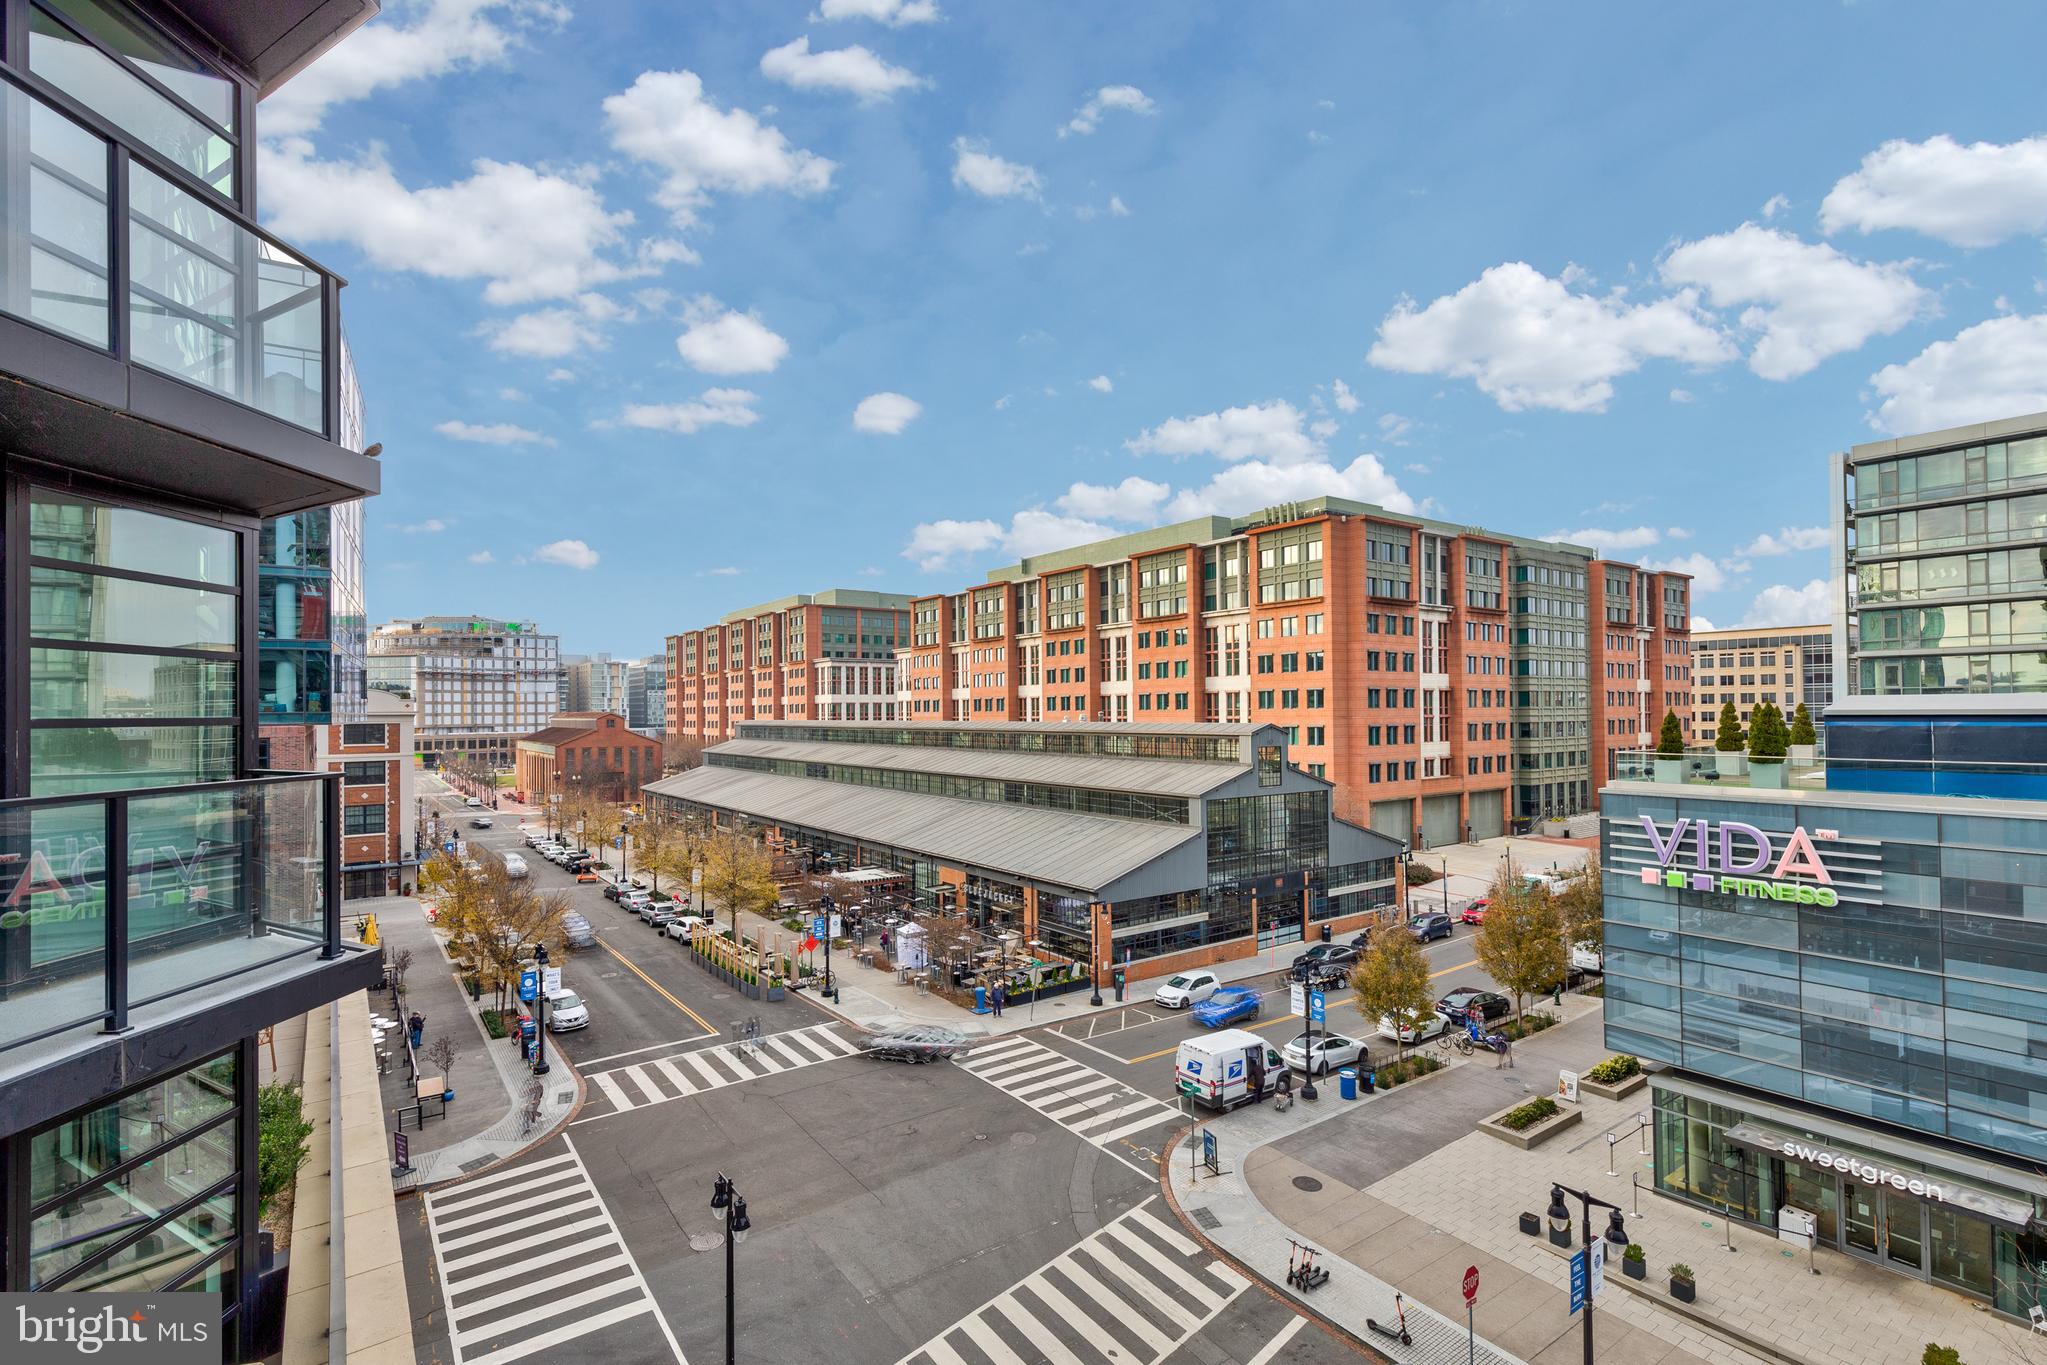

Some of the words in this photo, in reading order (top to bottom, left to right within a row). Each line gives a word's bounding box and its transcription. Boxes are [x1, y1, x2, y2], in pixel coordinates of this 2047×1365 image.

[1639, 815, 1833, 885] VIDA
[1721, 876, 1839, 907] FITNESS
[1783, 1142, 1943, 1202] sweetgreen
[1463, 1273, 1479, 1293] STOP
